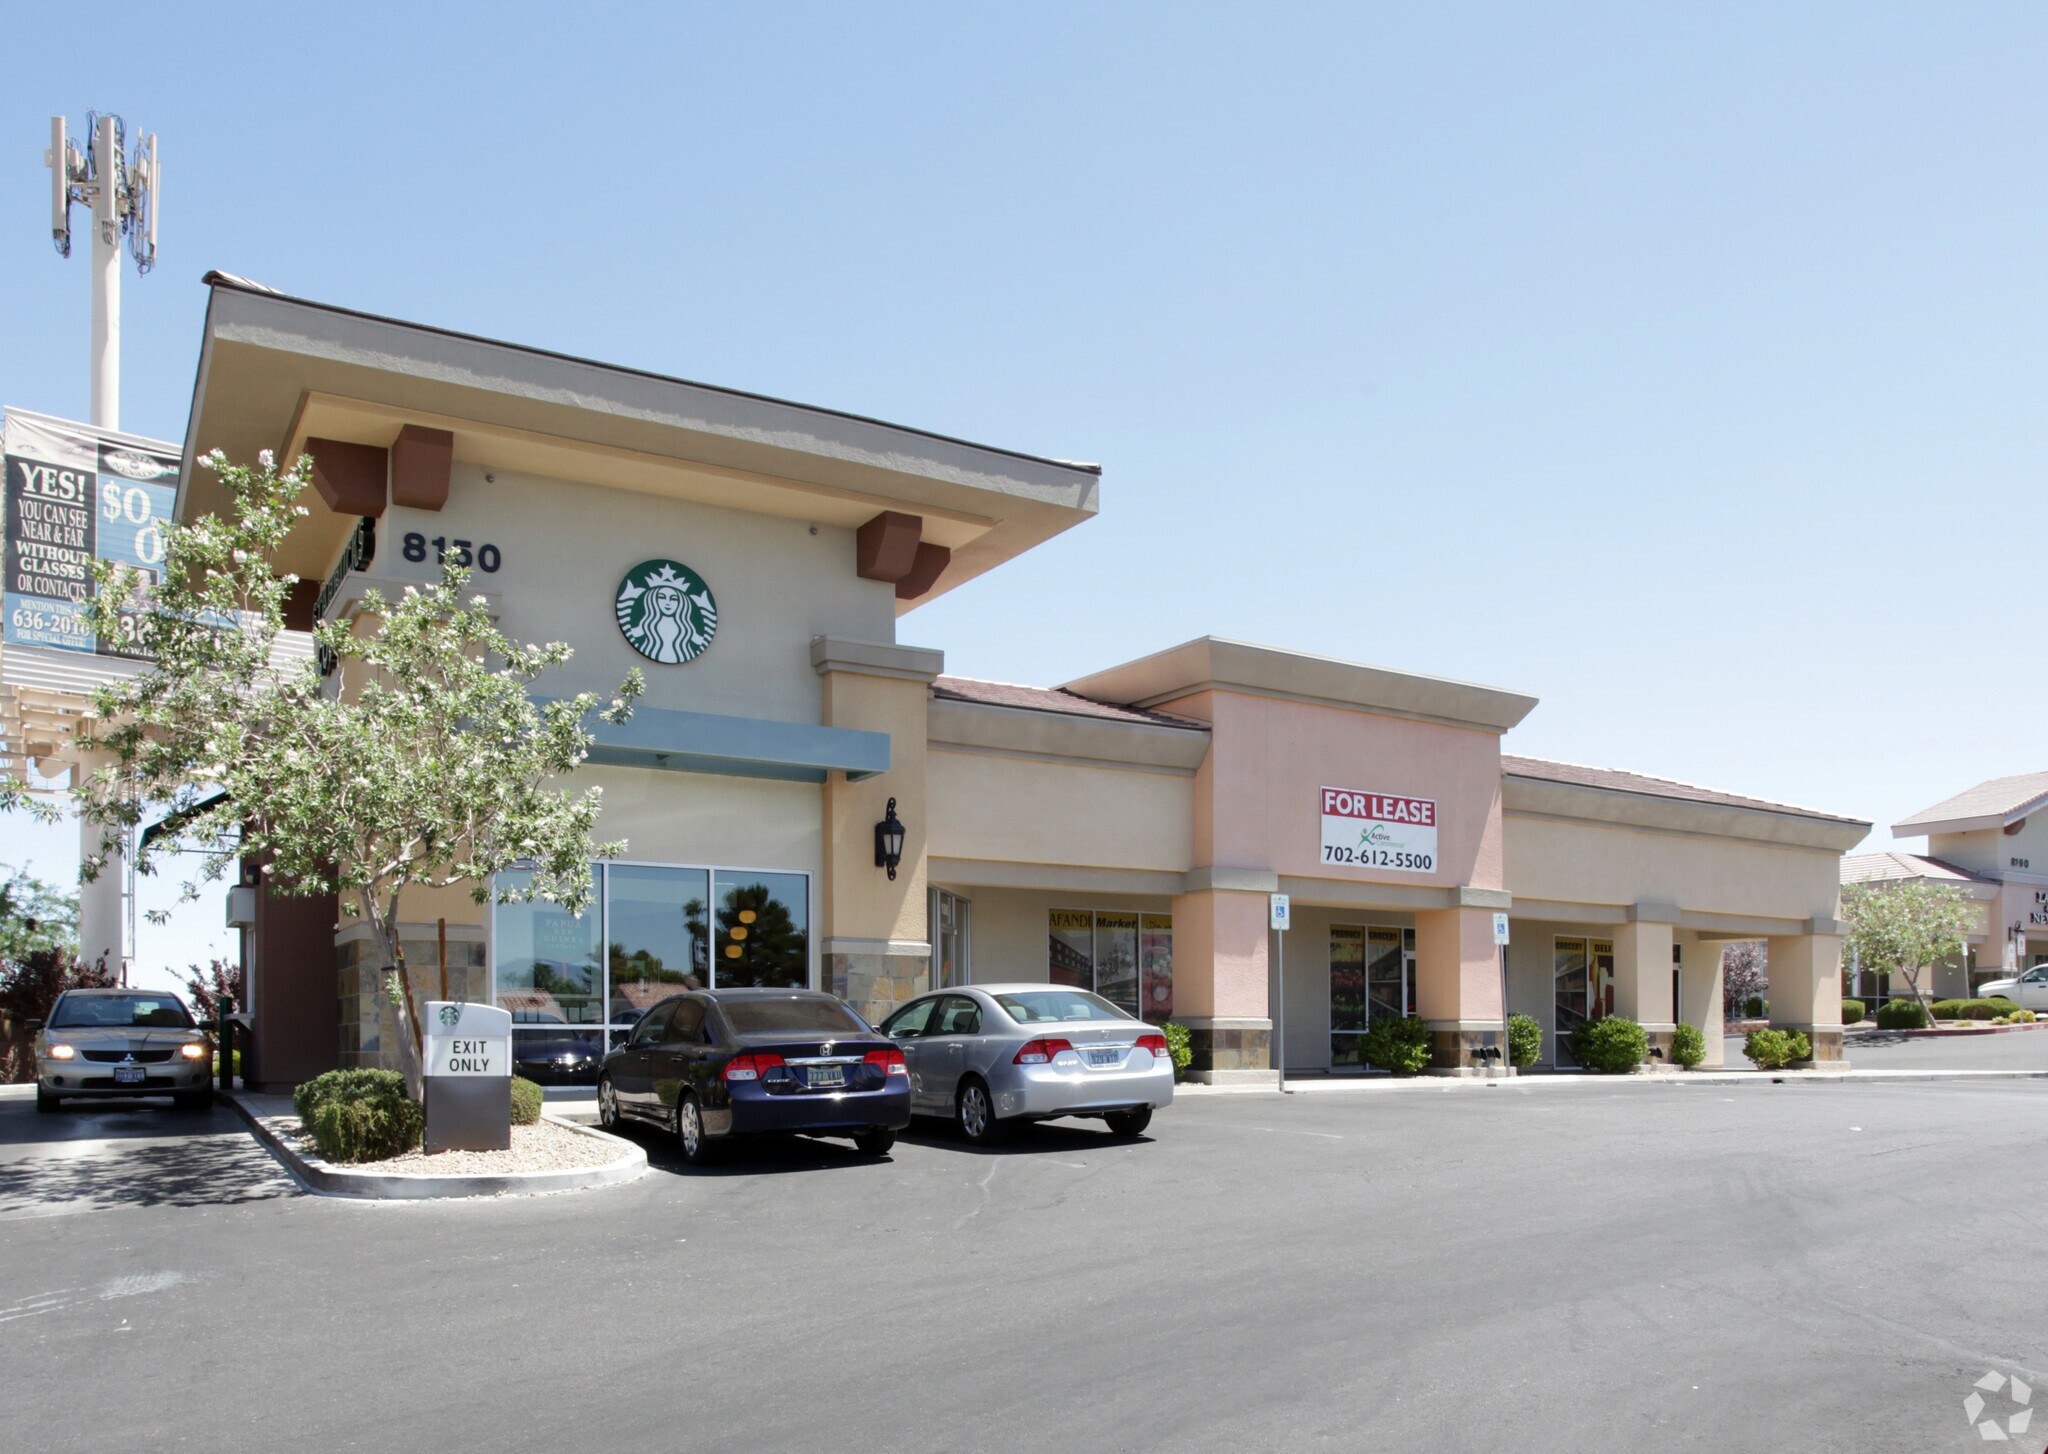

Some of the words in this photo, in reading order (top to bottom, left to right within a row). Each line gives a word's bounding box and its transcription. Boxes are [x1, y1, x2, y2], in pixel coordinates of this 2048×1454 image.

[18, 462, 86, 502] YES!
[102, 480, 151, 524] $0
[18, 499, 42, 520] YOU
[43, 504, 68, 526] CAN
[69, 508, 88, 529] SEE
[21, 519, 52, 542] NEAR
[53, 525, 63, 544] &
[64, 527, 85, 548] FAR
[16, 540, 89, 566] WITHOUT
[403, 532, 501, 573] 8150
[20, 557, 85, 580] GLASSES
[18, 574, 33, 592] OR
[35, 577, 87, 599] CONTACTS
[20, 598, 55, 613] MENTION
[17, 629, 32, 640] FOR
[33, 631, 61, 644] SPECIAL
[1324, 791, 1367, 816] FOR
[1371, 797, 1432, 823] LEASE
[1371, 832, 1391, 841] Active
[1324, 846, 1432, 870] 702-612-5500
[544, 918, 582, 929] PAPUA
[1049, 913, 1091, 929] AFANDI
[1095, 917, 1137, 930] Market
[1330, 929, 1362, 940] PRODUCE
[1368, 931, 1398, 942] GROCERY
[1555, 941, 1583, 951] GROCERY
[1594, 943, 1612, 953] DELI
[453, 1040, 487, 1054] EXIT
[449, 1058, 490, 1072] ONLY
